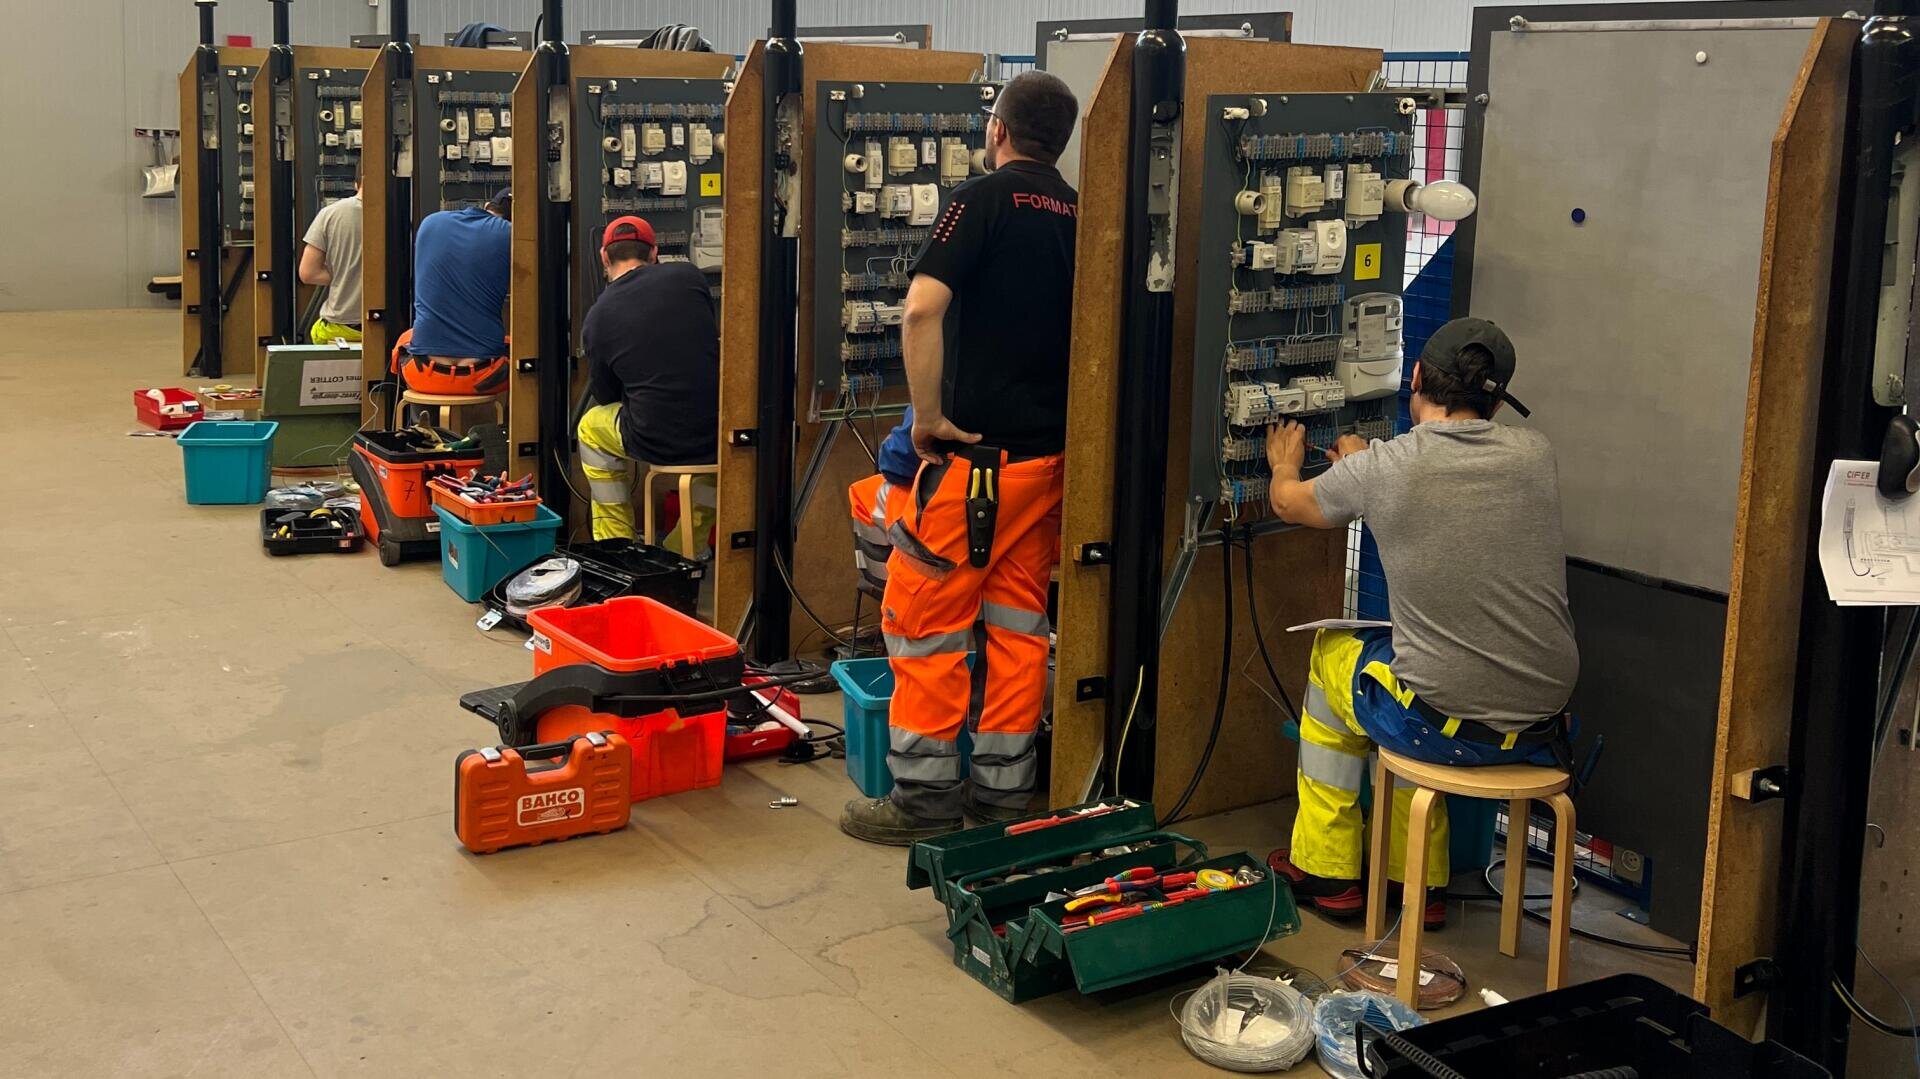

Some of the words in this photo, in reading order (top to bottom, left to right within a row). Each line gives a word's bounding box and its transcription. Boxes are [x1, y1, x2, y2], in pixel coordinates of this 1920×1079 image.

[708, 180, 714, 188] 4
[1364, 254, 1372, 268] 6
[310, 375, 344, 383] COTTIER
[1846, 470, 1871, 480] CIFER
[404, 480, 416, 501] 7
[522, 790, 580, 810] BAHCO
